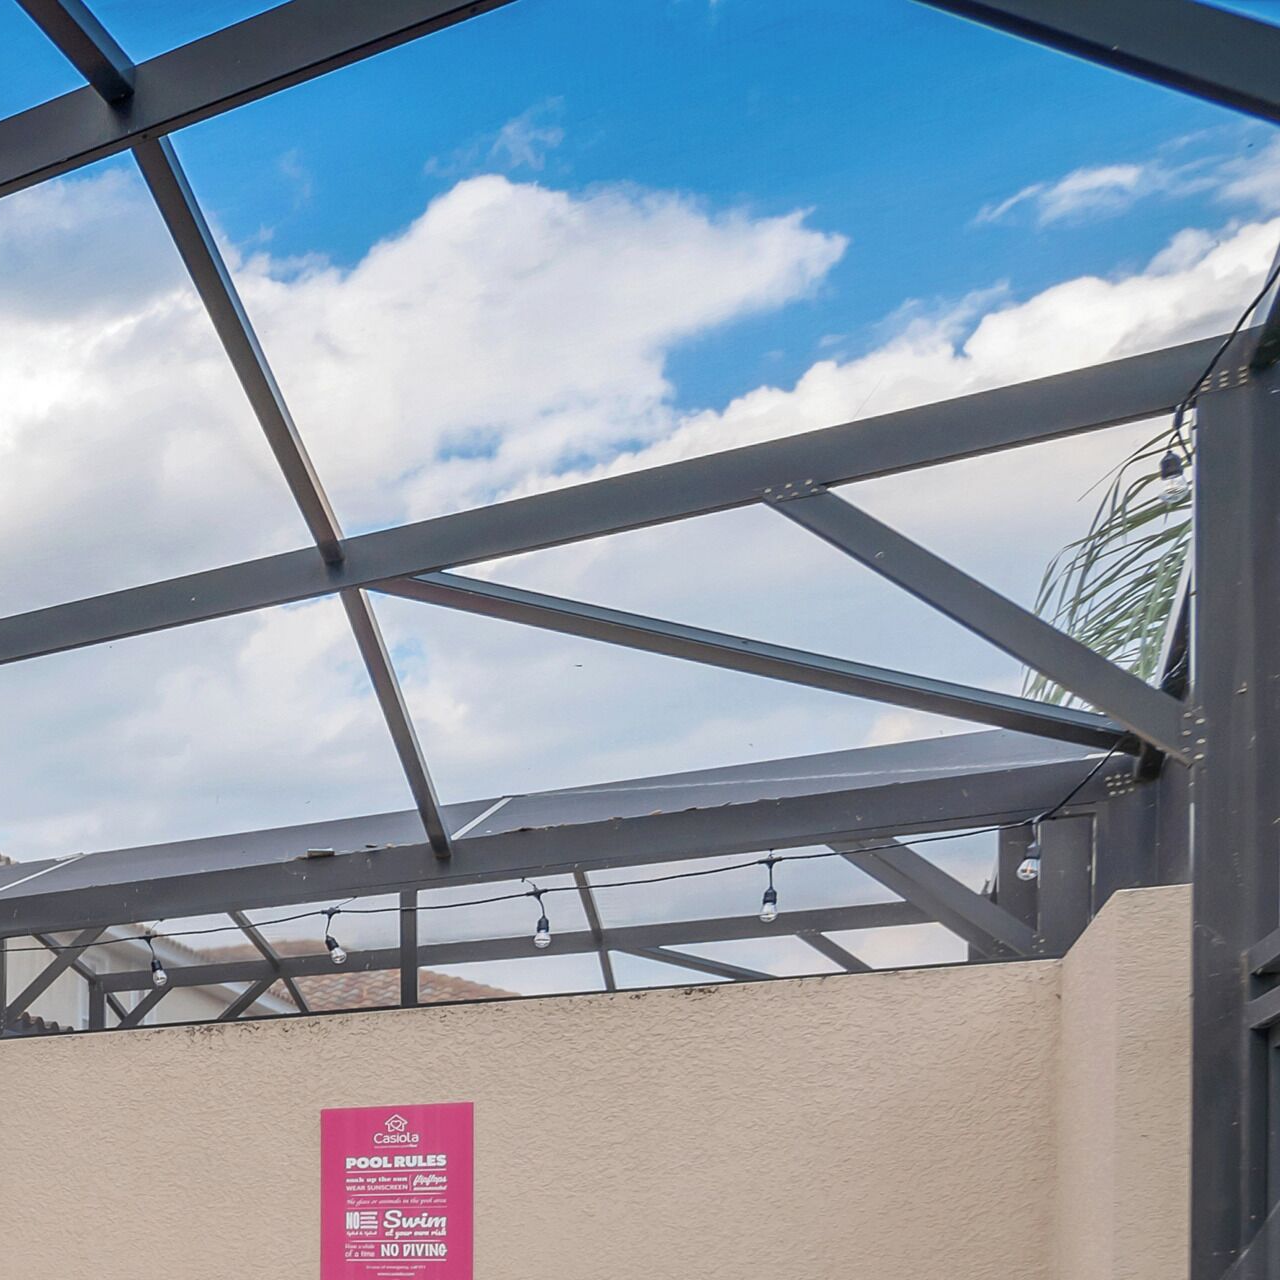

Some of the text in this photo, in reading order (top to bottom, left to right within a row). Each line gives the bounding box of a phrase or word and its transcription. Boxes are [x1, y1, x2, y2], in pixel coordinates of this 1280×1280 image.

[373, 1132, 419, 1144] Casiola
[345, 1154, 447, 1169] POOL RULES
[345, 1211, 360, 1230] NO
[383, 1209, 447, 1229] Swim
[394, 1230, 413, 1240] your
[380, 1243, 448, 1257] NO DIVING
